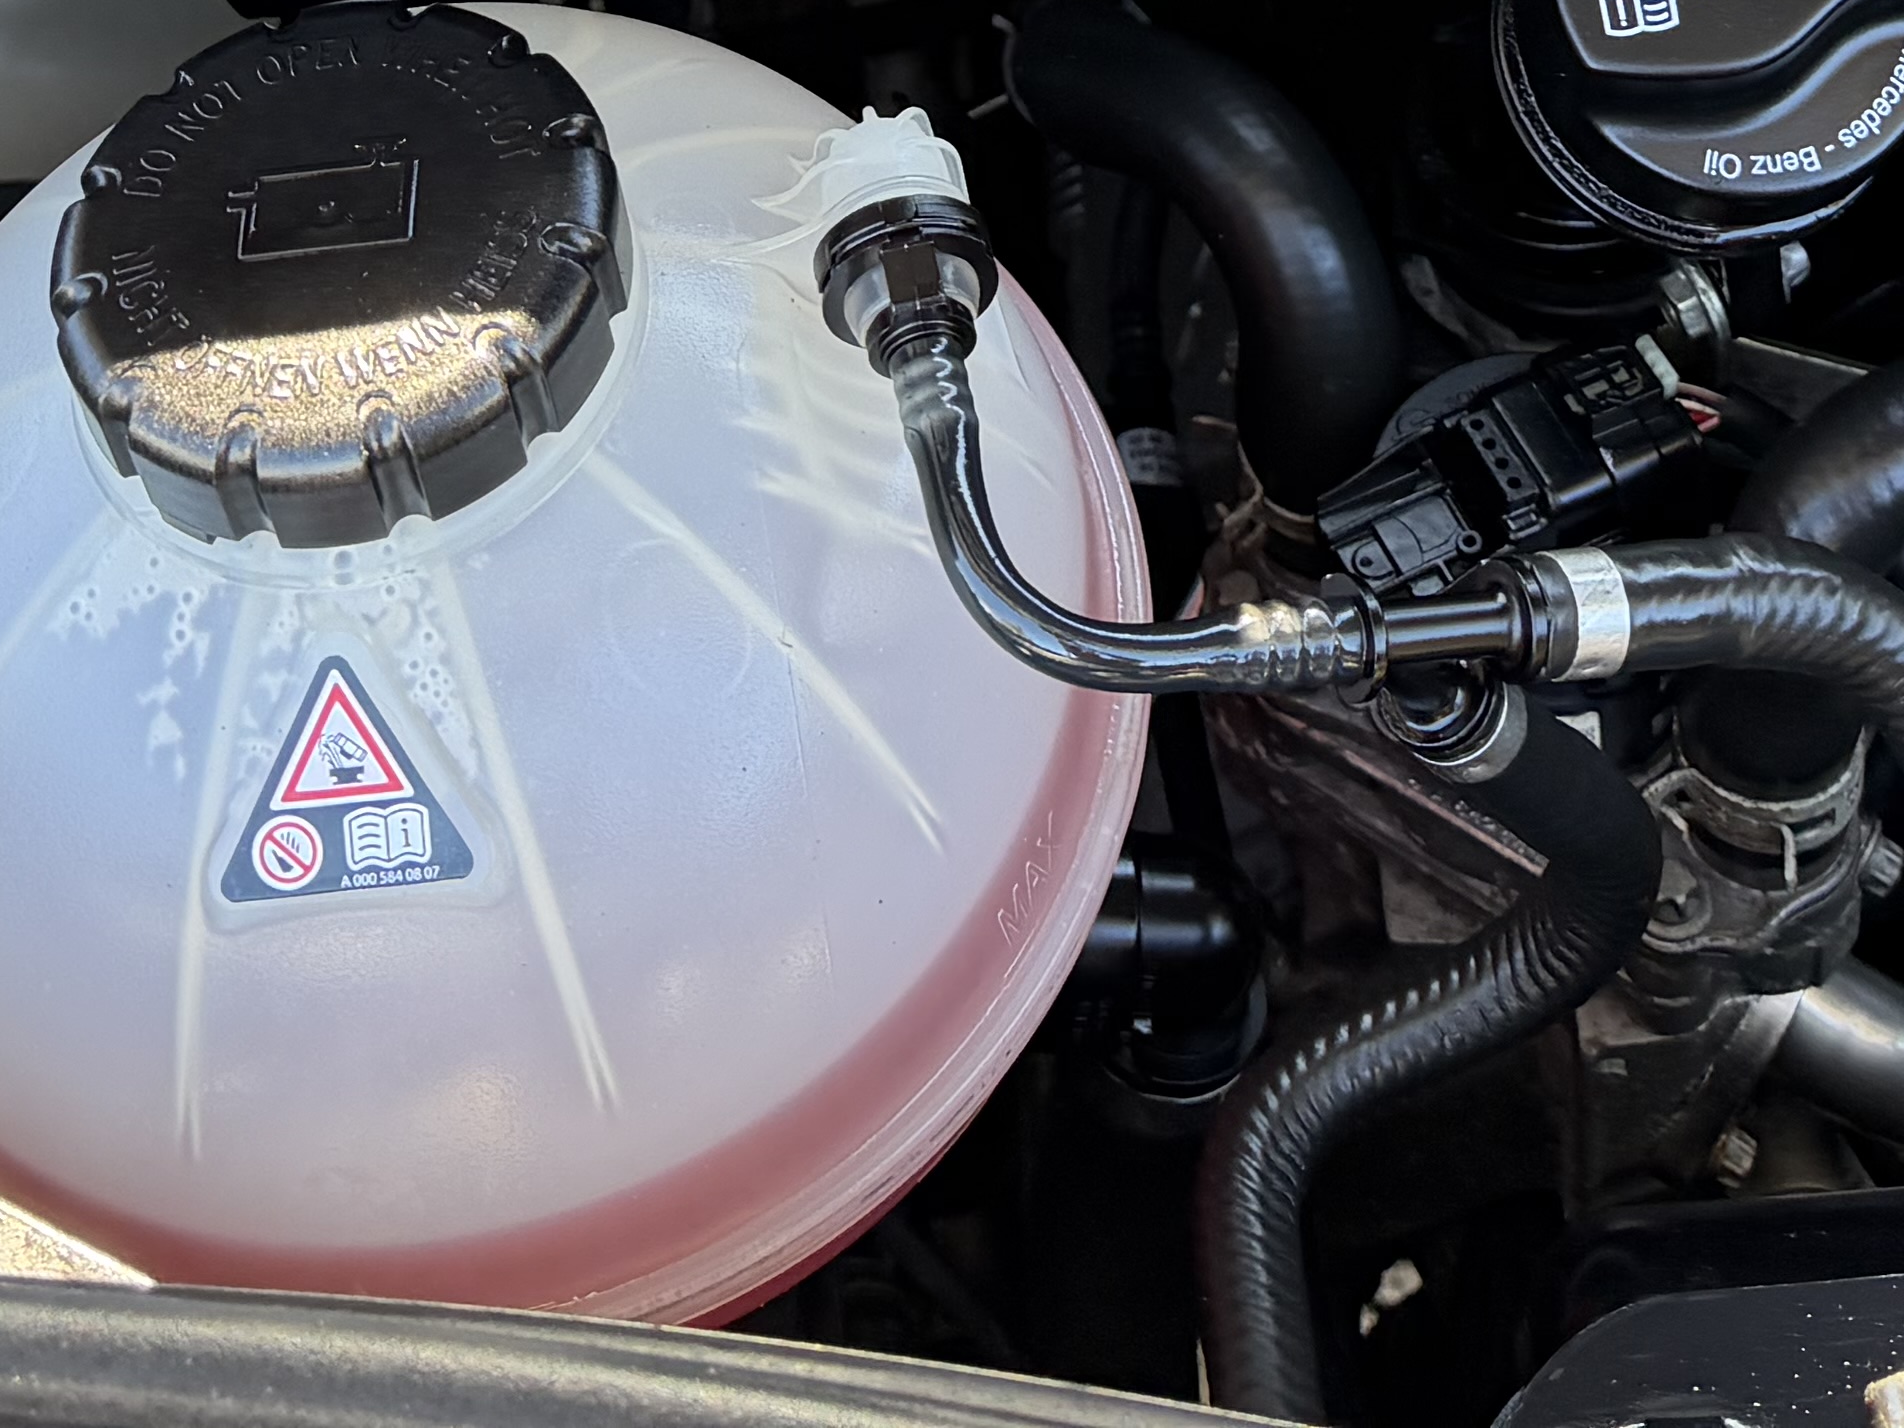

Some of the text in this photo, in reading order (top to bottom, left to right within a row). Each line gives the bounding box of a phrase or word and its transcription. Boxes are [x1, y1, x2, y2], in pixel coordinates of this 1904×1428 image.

[122, 148, 176, 198] DO
[164, 78, 241, 144] NOT
[1704, 148, 1741, 179] Oil
[1750, 141, 1822, 175] Benz
[338, 309, 464, 389] WENN
[340, 865, 440, 888] A 000 584 08 07
